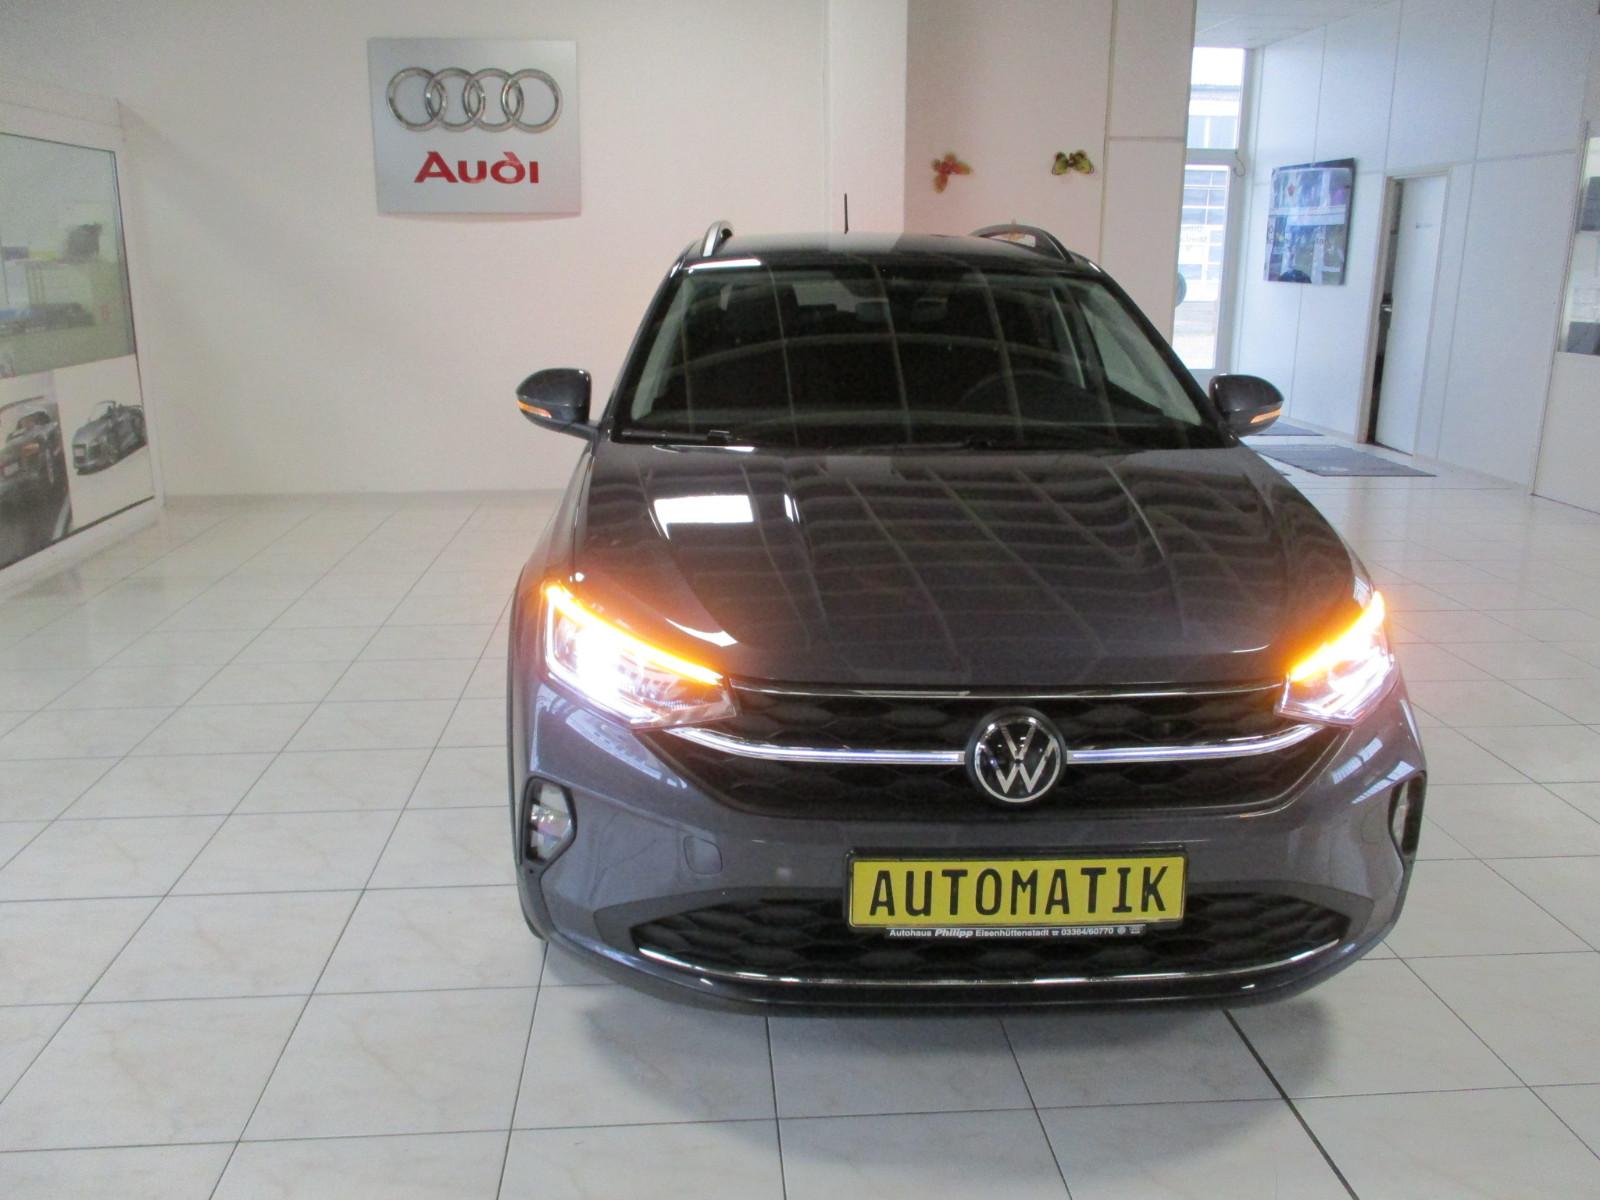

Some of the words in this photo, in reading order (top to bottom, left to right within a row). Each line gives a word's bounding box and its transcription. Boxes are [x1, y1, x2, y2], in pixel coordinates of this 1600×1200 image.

[414, 151, 539, 184] Audi
[869, 865, 1168, 917] AUTOMATIK
[889, 928, 932, 937] Autohaus
[934, 928, 973, 938] Philipp
[975, 927, 1049, 937] Eisenhüttenstadt
[1061, 926, 1114, 936] 03364/60770
